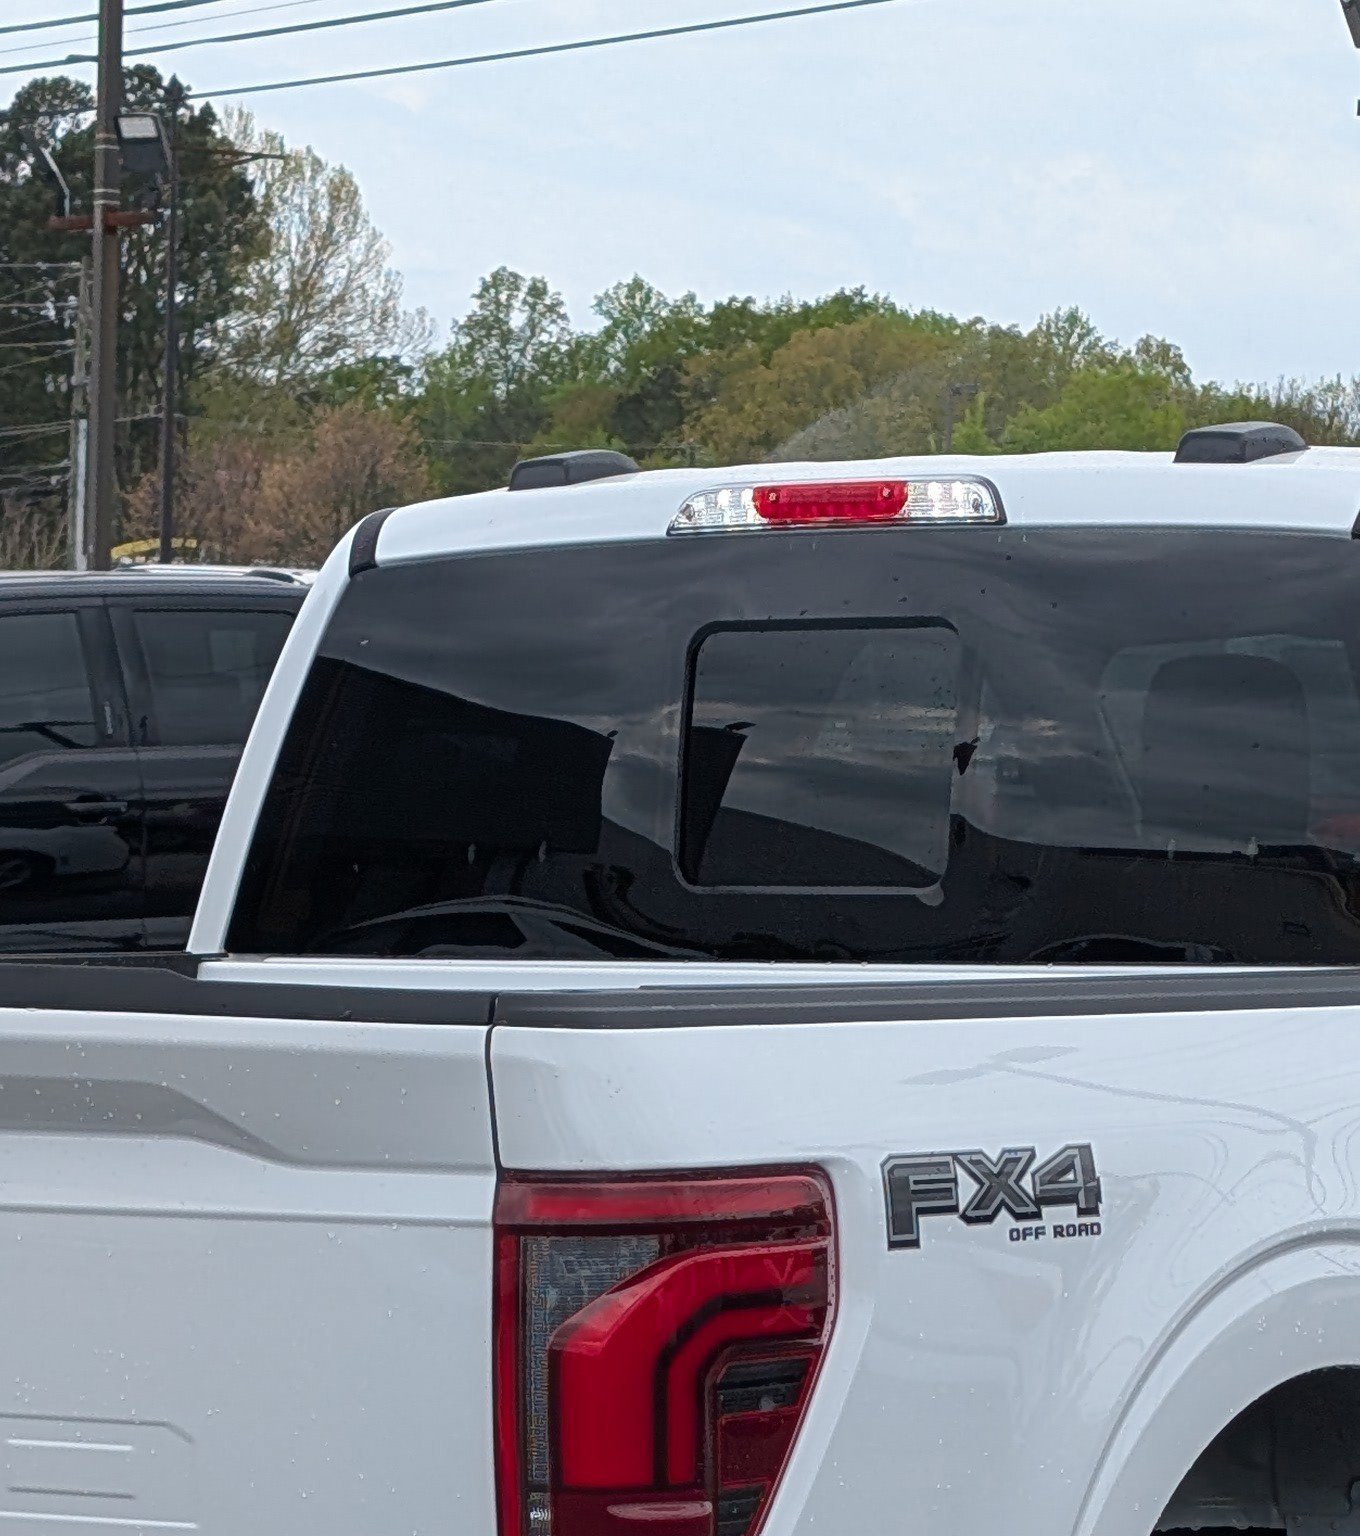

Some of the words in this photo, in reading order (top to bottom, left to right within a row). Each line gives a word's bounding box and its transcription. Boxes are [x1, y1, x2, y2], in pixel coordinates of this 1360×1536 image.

[880, 1142, 1103, 1252] FX4
[1008, 1224, 1047, 1242] OFF
[1053, 1221, 1102, 1239] ROAD
